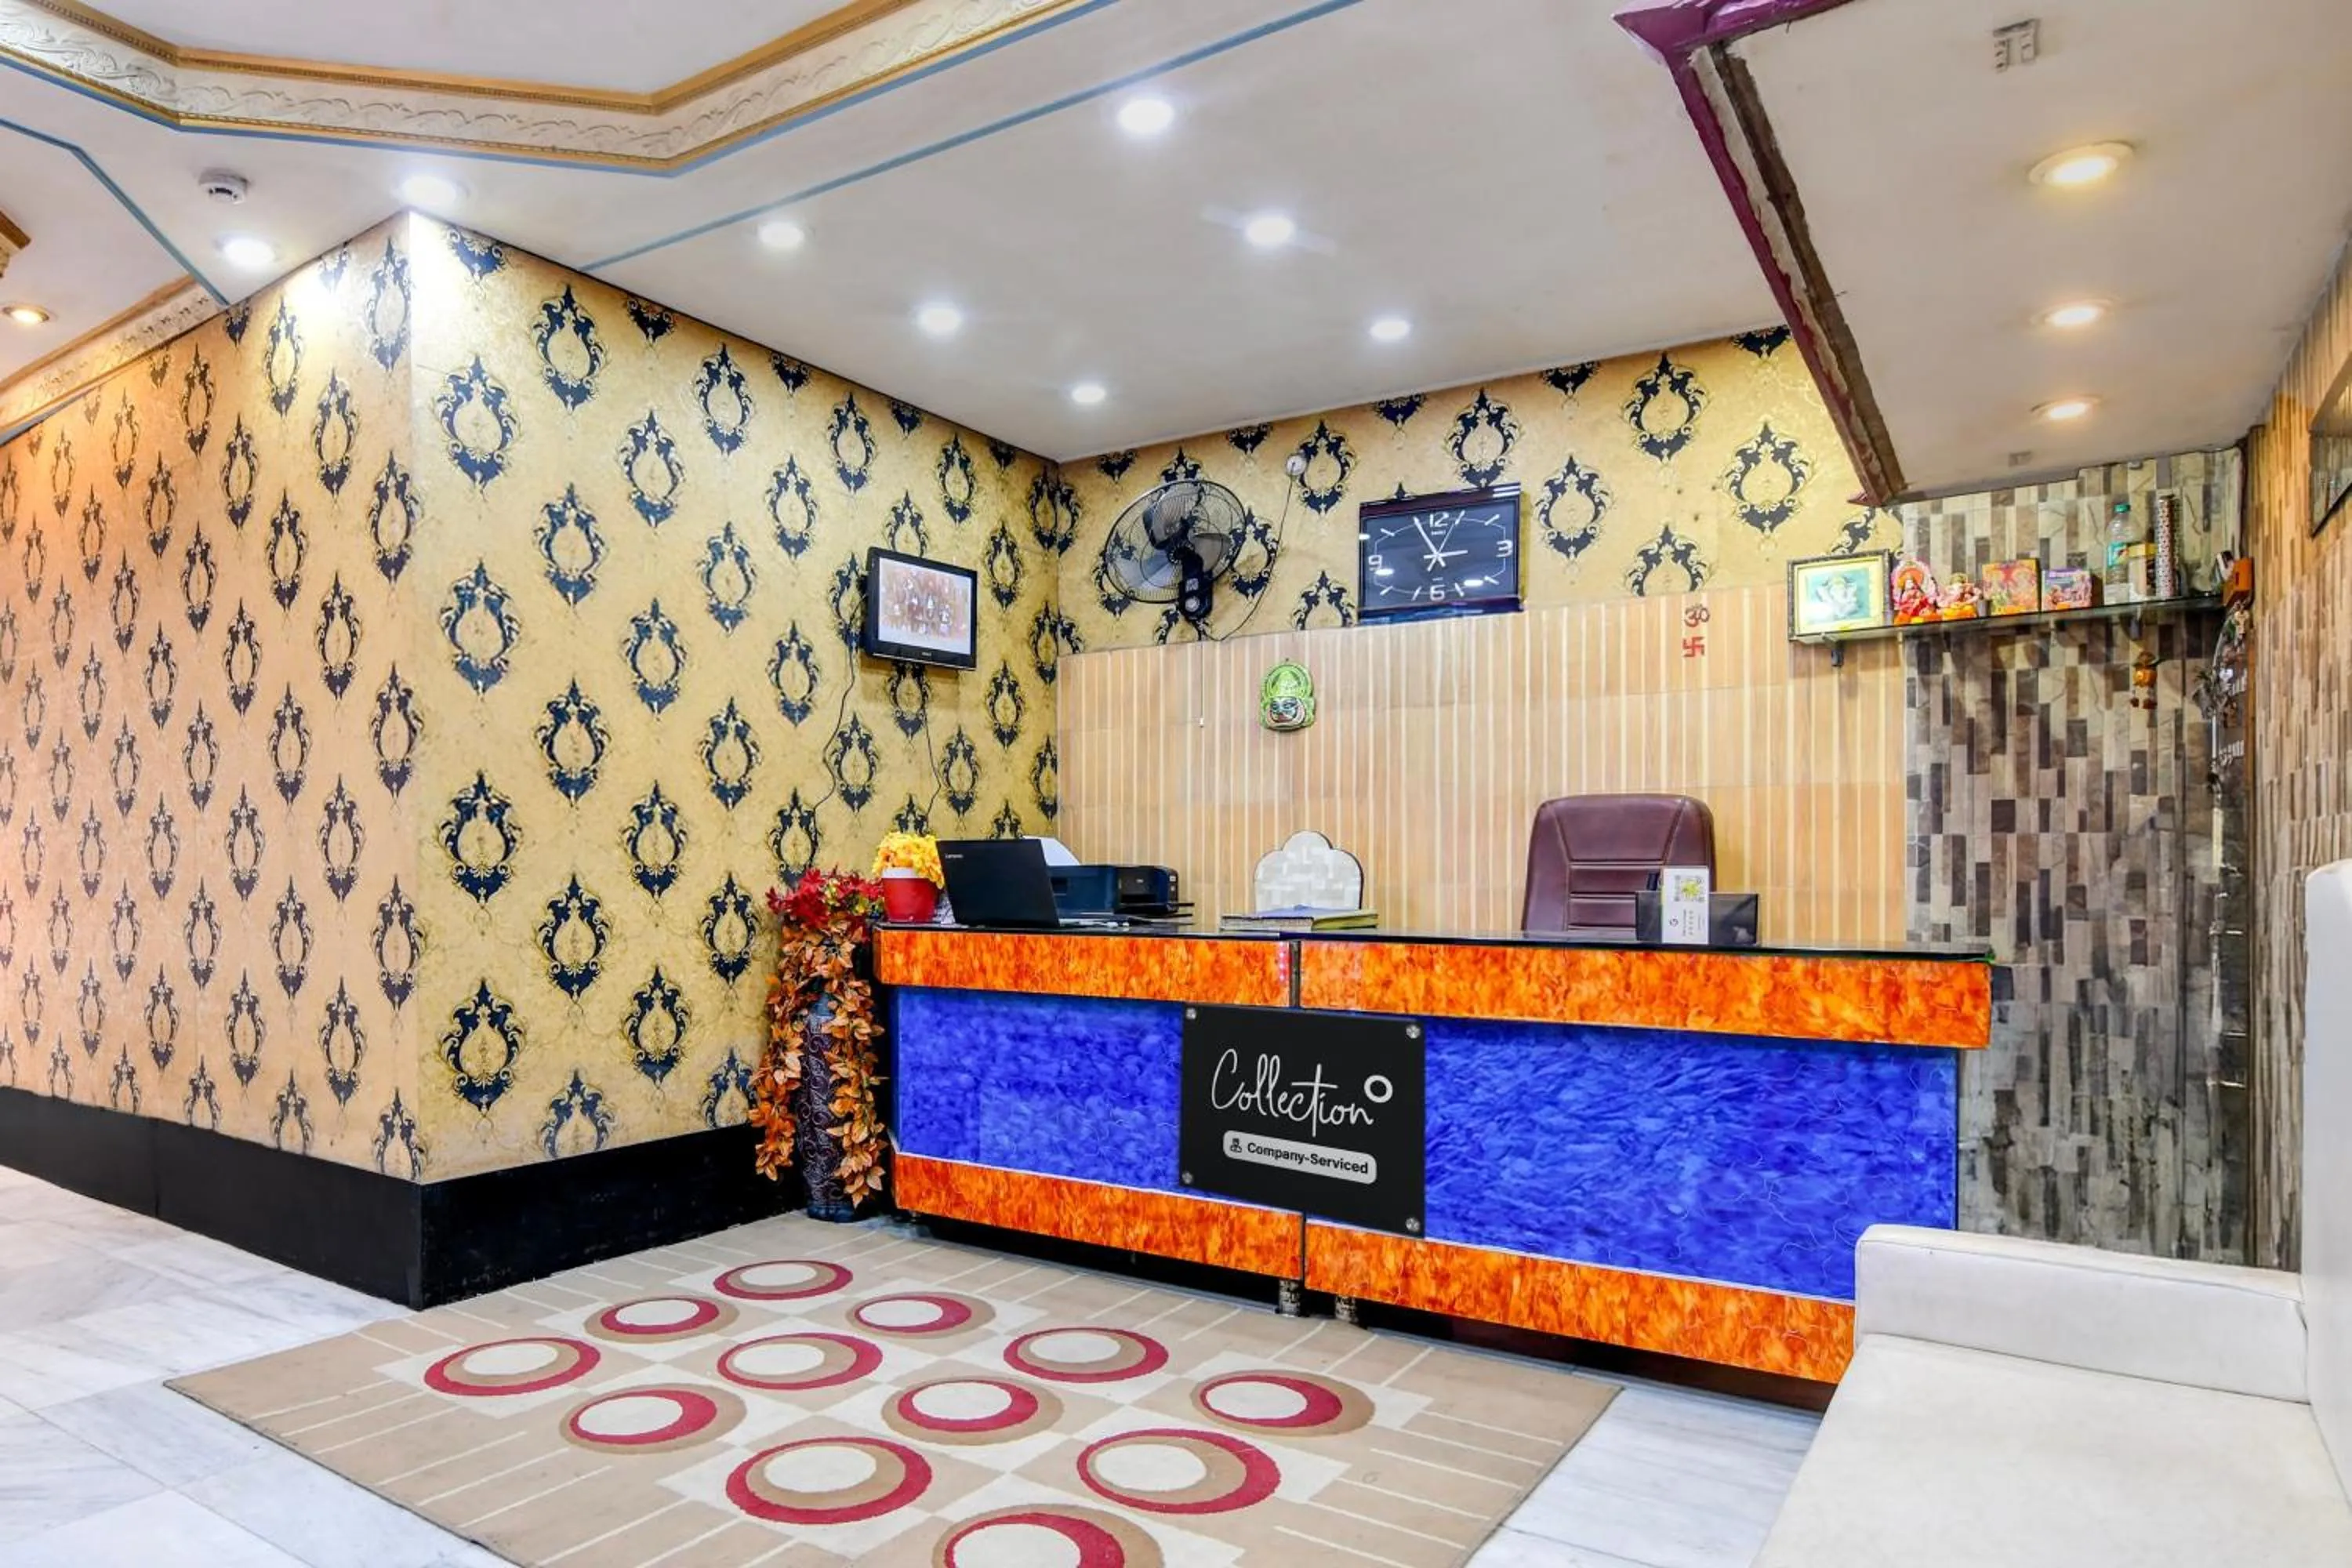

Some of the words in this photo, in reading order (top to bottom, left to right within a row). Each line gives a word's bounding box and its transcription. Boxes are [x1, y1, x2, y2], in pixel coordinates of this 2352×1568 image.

[1429, 511, 1449, 528] 12
[1496, 539, 1513, 557] 3
[1368, 554, 1382, 571] 9
[1430, 584, 1446, 601] 6
[1211, 1048, 1374, 1137] Collection
[1247, 1142, 1368, 1174] Company-Serviced
